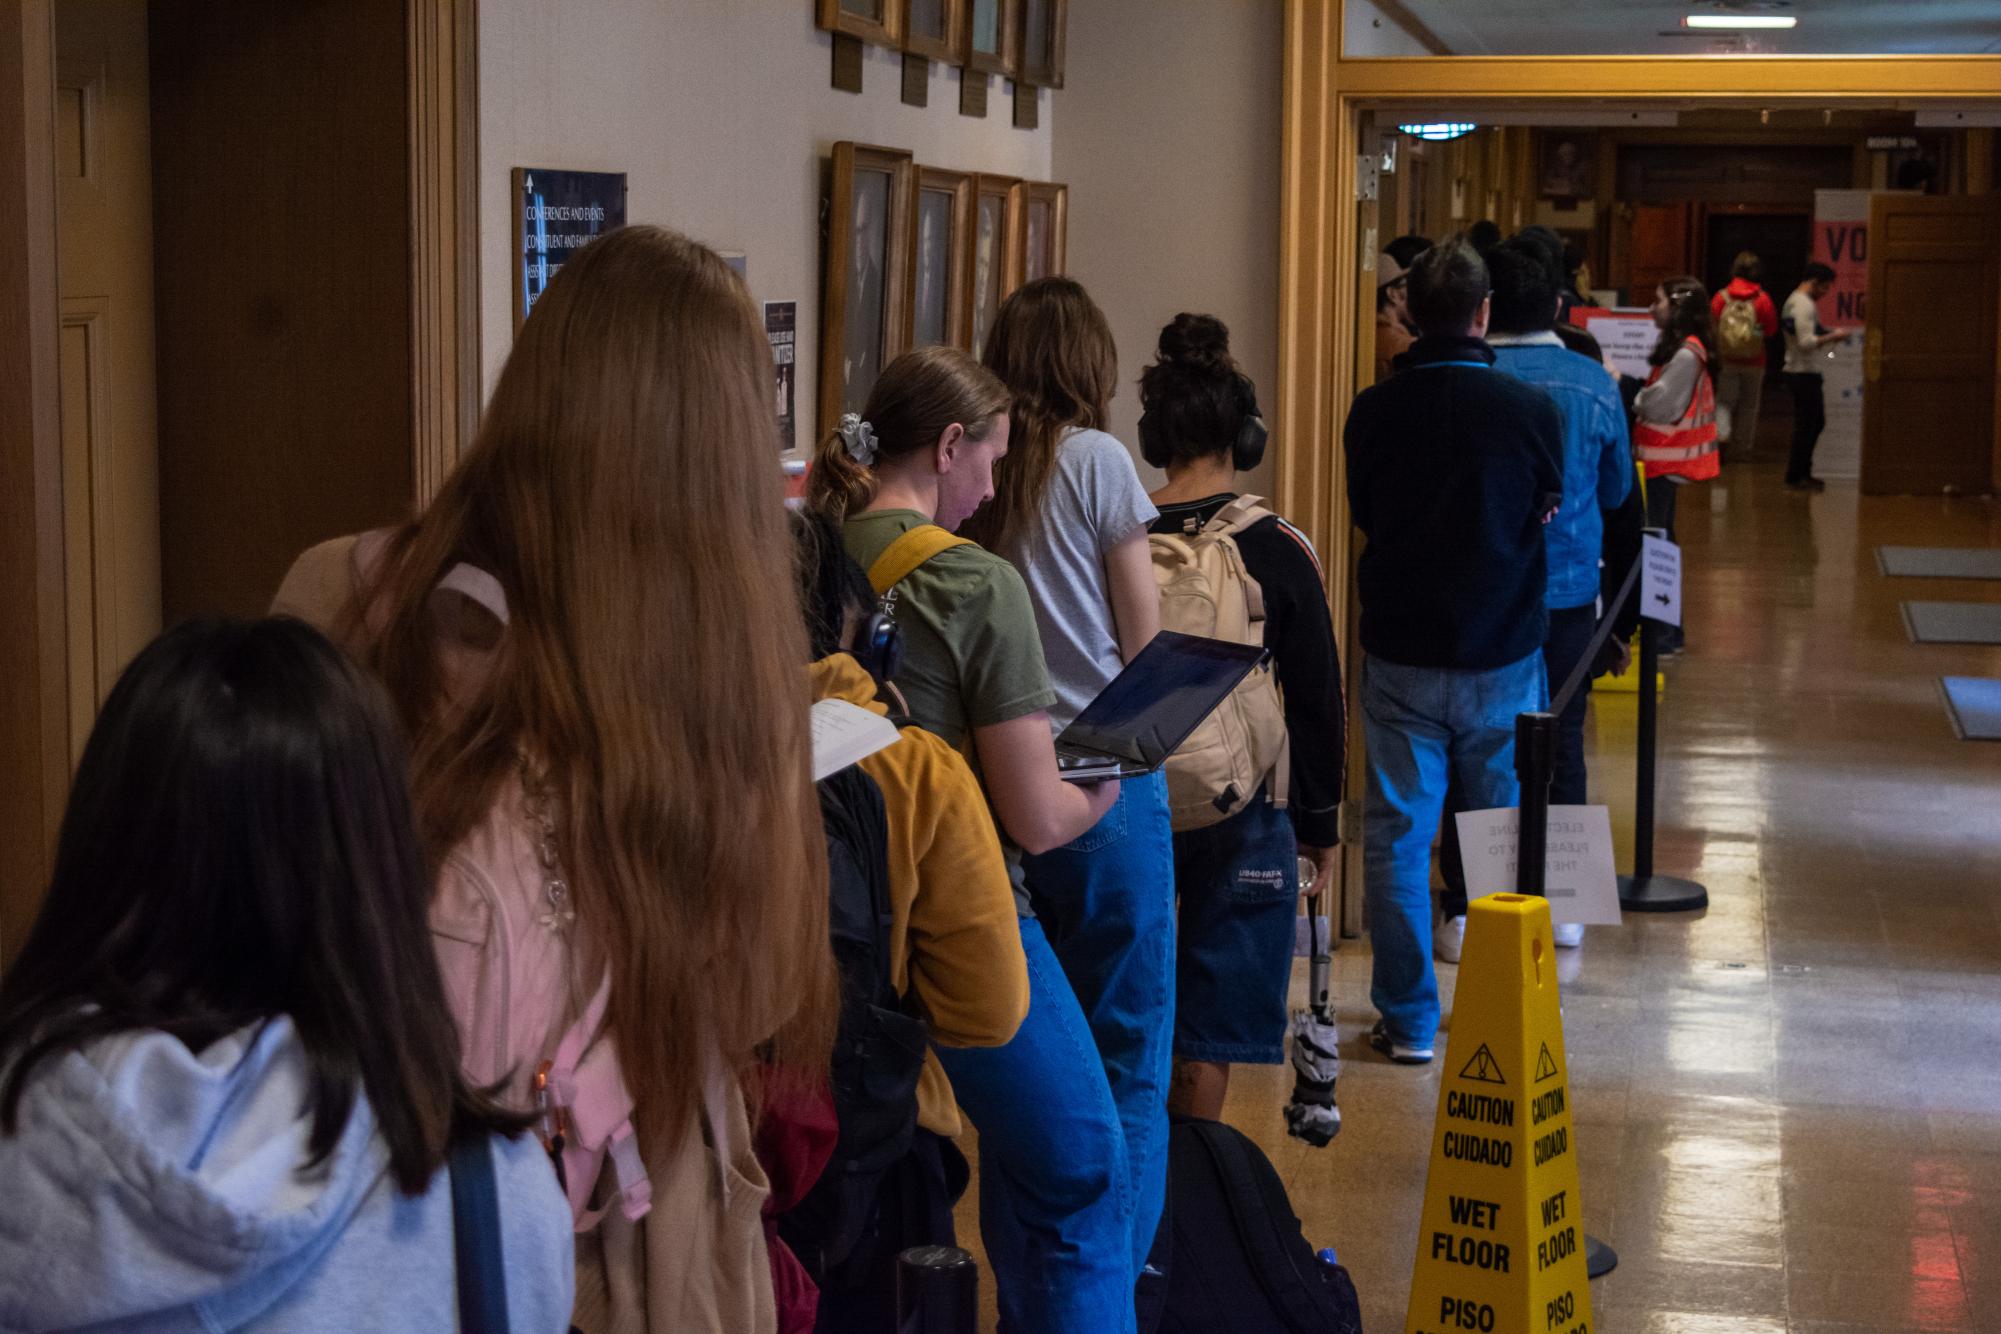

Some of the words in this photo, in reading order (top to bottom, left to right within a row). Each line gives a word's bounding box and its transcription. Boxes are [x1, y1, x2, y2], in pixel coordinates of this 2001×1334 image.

[571, 207, 584, 220] AND
[584, 207, 605, 221] EVENTS
[564, 235, 576, 248] AND
[1447, 1090, 1514, 1127] CAUTION
[1532, 1086, 1565, 1125] CAUTION
[1443, 1130, 1512, 1168] CUIDADO
[1534, 1126, 1567, 1167] CUIDADO
[1449, 1195, 1500, 1230] WET
[1541, 1190, 1566, 1228] WET
[1432, 1231, 1510, 1273] FLOOR
[1537, 1226, 1576, 1272] FLOOR
[1440, 1295, 1495, 1333] PISO
[1546, 1290, 1574, 1331] PISO
